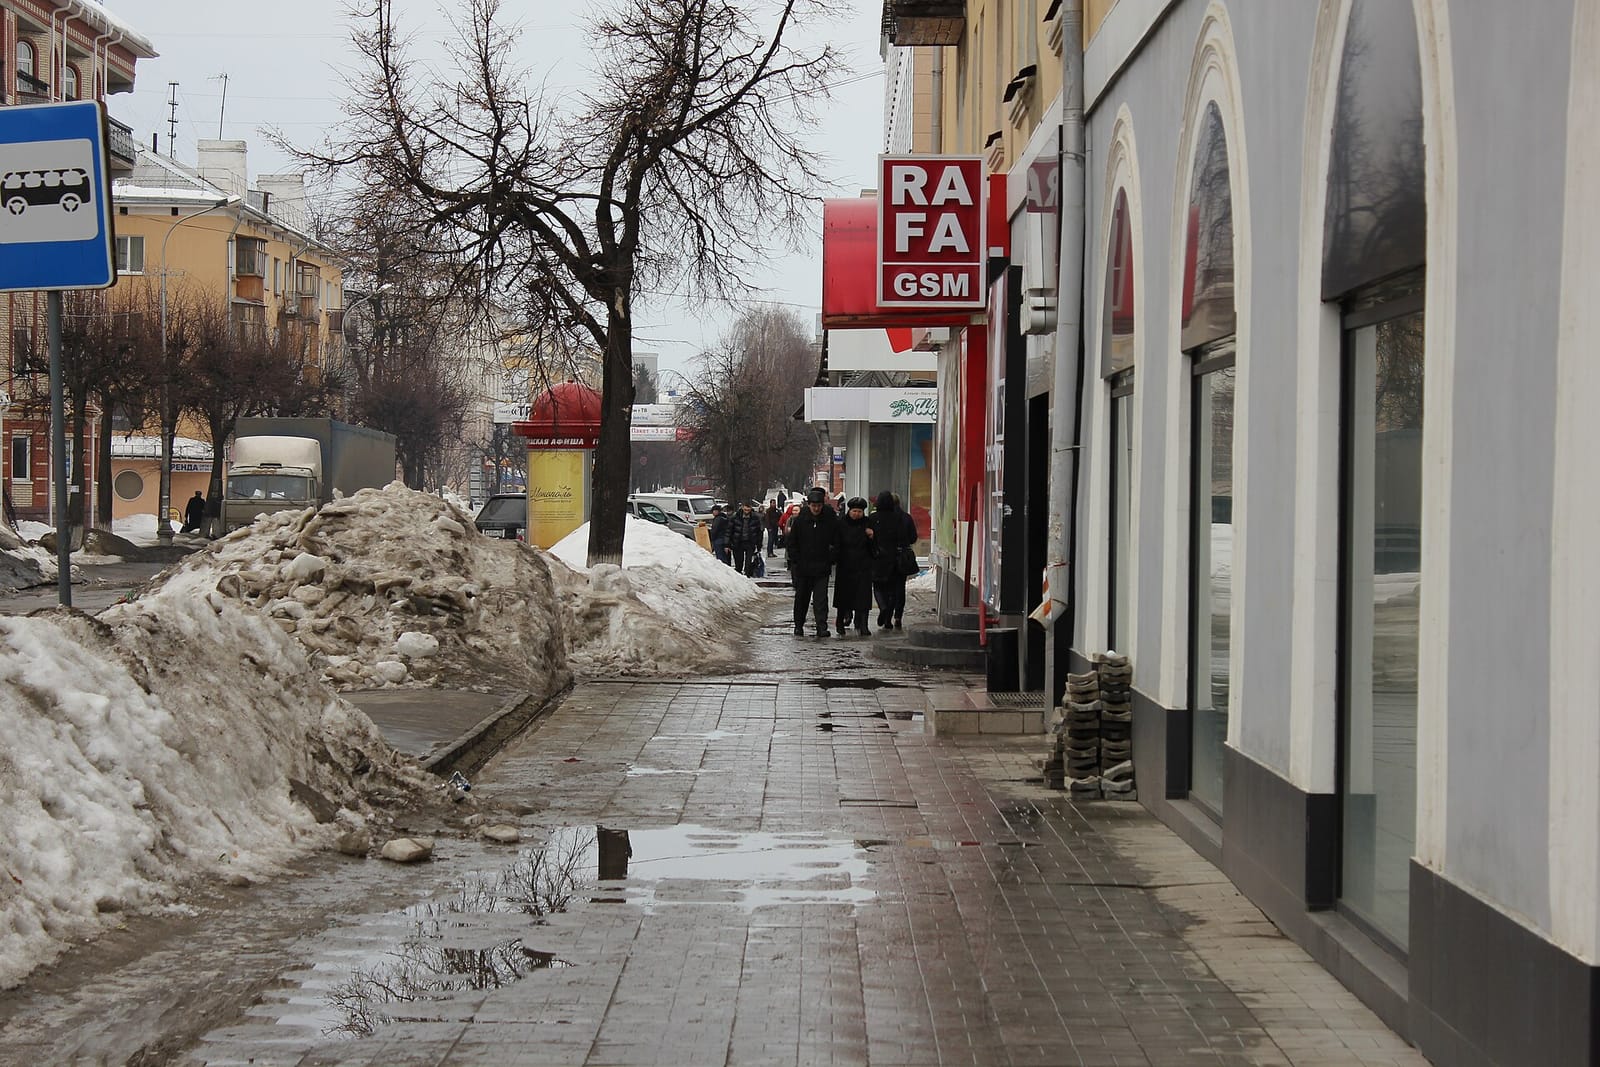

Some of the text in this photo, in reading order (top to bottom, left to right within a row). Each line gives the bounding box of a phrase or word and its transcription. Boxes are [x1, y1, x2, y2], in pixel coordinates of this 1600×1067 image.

[891, 165, 974, 206] RA
[895, 212, 970, 253] FA
[893, 273, 969, 297] GSM
